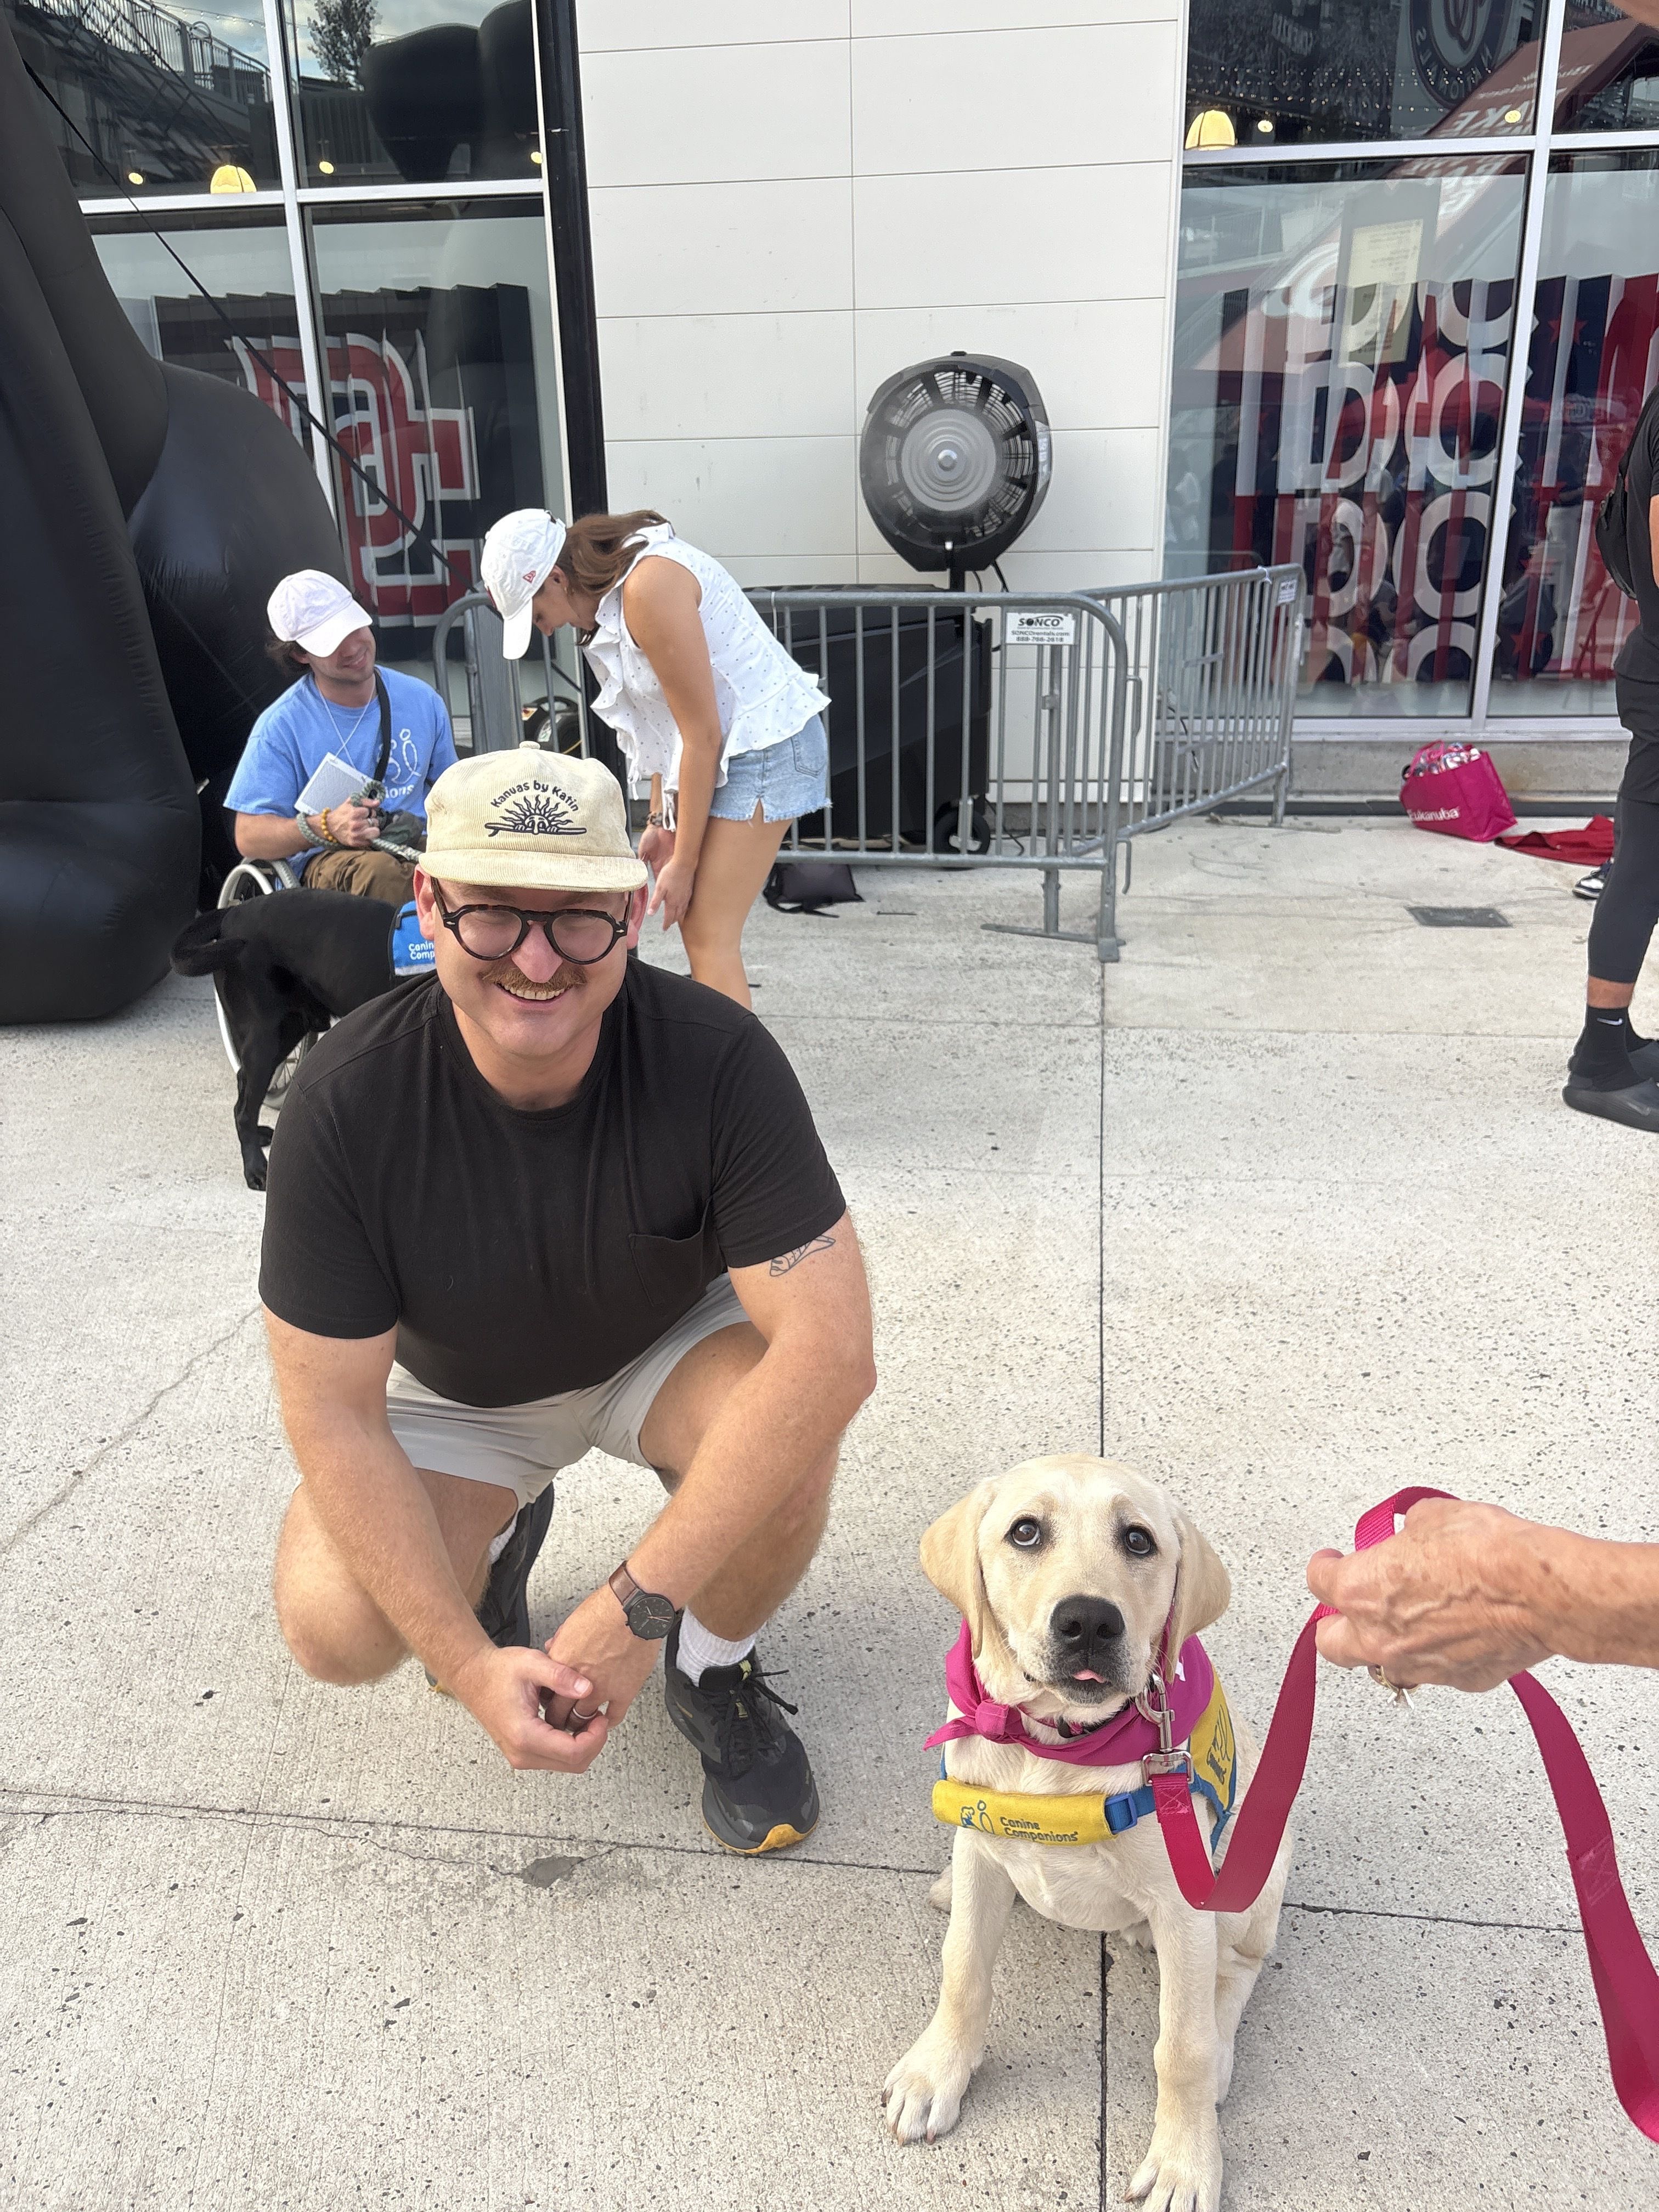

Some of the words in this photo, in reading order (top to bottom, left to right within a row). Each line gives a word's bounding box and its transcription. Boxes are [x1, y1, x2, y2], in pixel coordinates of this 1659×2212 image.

[1018, 618, 1060, 627] SONCO
[490, 782, 530, 808] Kanvas
[533, 780, 549, 792] by
[552, 786, 579, 811] Katin
[408, 941, 435, 952] Canin
[1000, 1816, 1040, 1830] Canine
